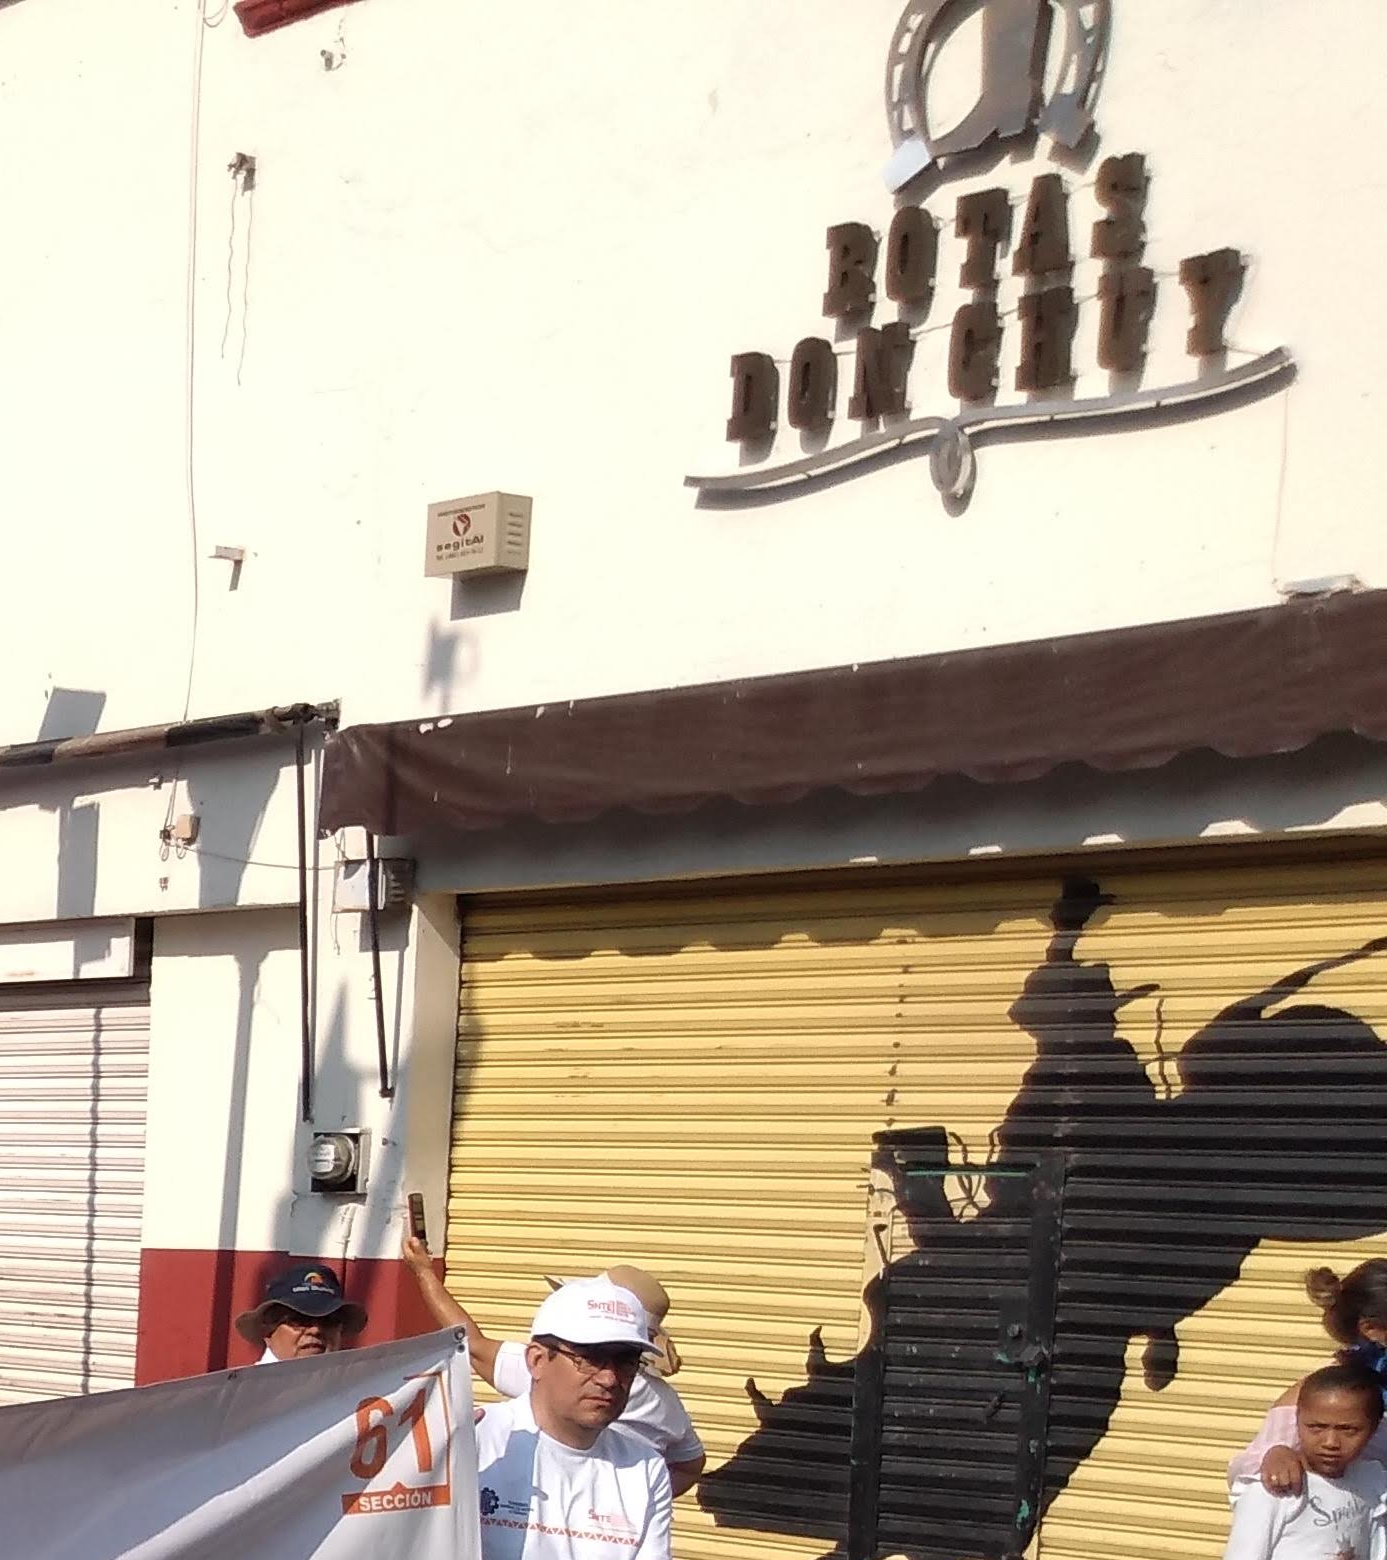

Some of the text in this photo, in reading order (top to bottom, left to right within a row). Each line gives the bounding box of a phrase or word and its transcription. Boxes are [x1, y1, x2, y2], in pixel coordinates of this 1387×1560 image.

[823, 151, 1151, 320] BOTAS
[726, 247, 1243, 444] DON CHUY
[349, 1387, 434, 1480] 61
[358, 1489, 432, 1514] SECCIÓN
